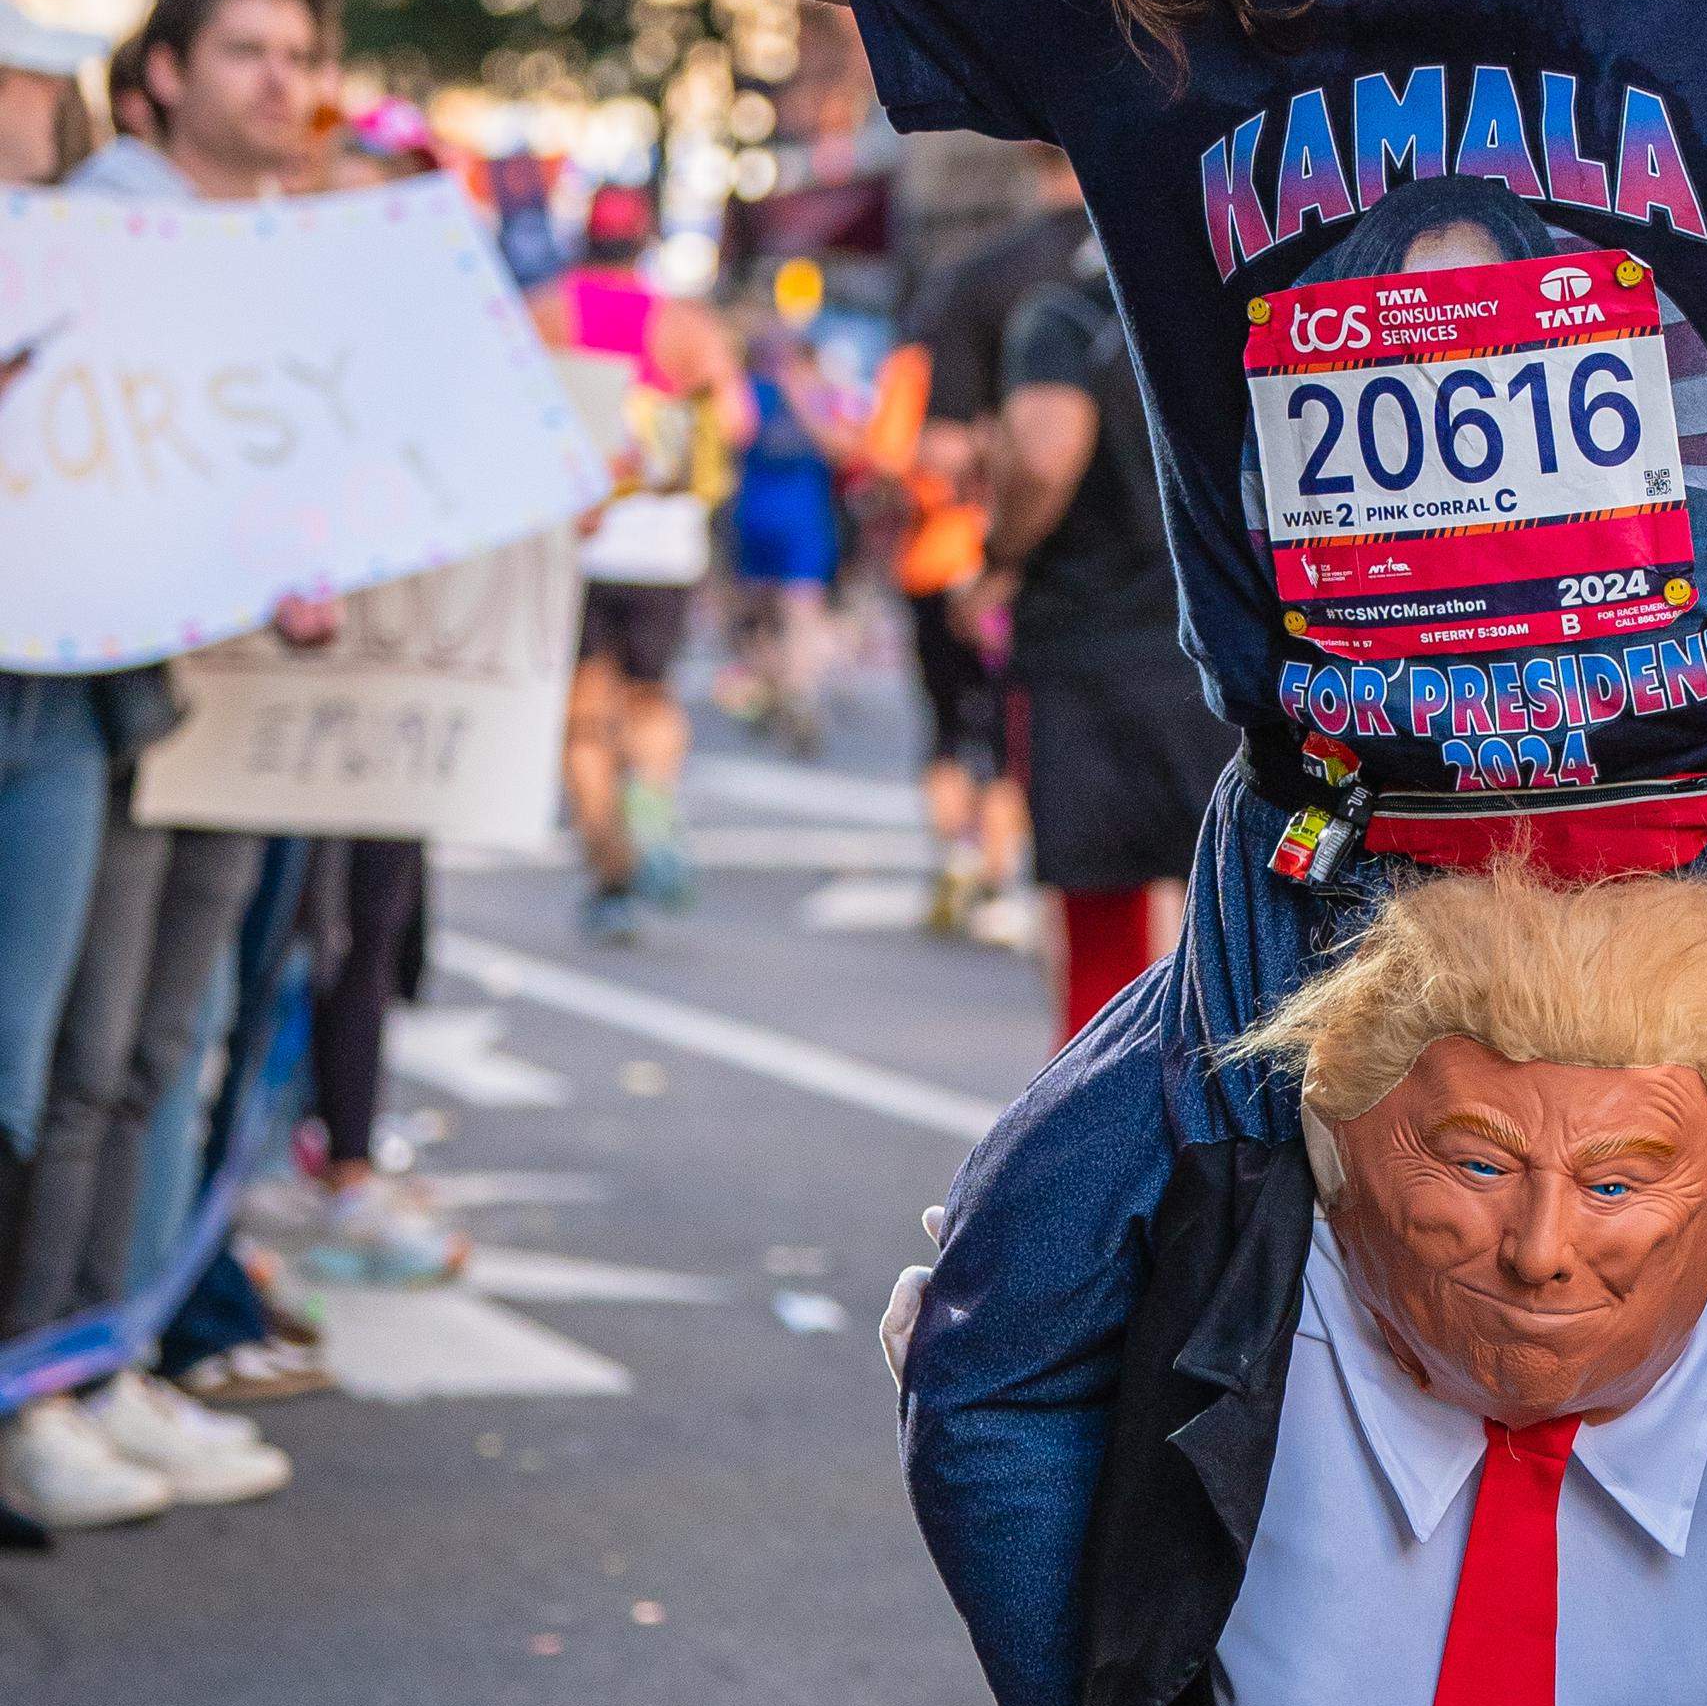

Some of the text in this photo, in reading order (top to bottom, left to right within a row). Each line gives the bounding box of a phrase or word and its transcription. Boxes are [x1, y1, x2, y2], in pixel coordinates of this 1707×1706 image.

[1376, 287, 1428, 306] TATA
[1378, 299, 1499, 326] CONSULTANCY
[1535, 304, 1606, 329] TATA
[1381, 324, 1458, 346] SERVICES
[1288, 352, 1641, 496] 20616
[1282, 488, 1518, 528] WAVE 2 PINK CORRAL C
[1558, 569, 1650, 608] 2024
[1326, 599, 1487, 622] #TCSNYCMarathon
[1597, 610, 1615, 620] FOR
[1616, 606, 1640, 617] RACE
[1420, 623, 1529, 643] SI FERRY 5:30AM
[1561, 614, 1582, 636] B
[1615, 618, 1637, 628] CALL
[1279, 661, 1397, 737] FOR
[1441, 730, 1598, 792] 2024
